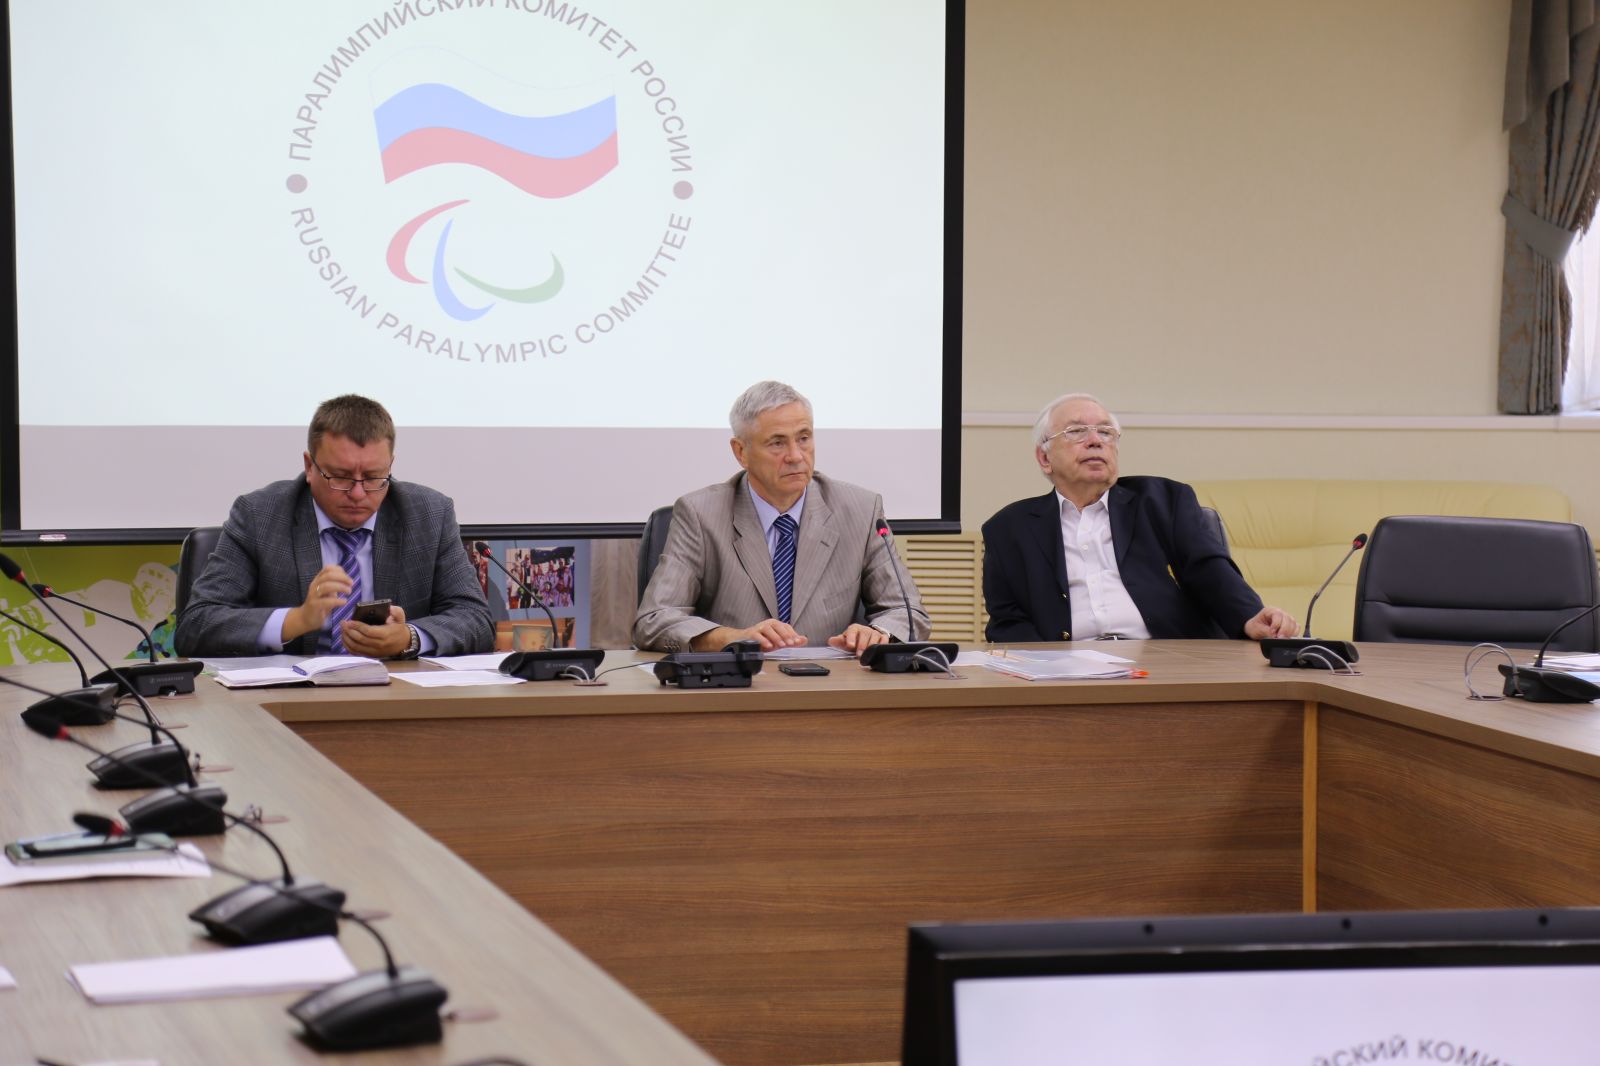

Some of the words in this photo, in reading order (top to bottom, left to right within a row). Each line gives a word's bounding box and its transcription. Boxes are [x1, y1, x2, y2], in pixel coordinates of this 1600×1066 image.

[629, 60, 693, 173] РОССИИ
[290, 208, 378, 319] RUSSIAN
[376, 311, 568, 364] PARALYMPIC
[574, 213, 692, 345] COMMITTEE
